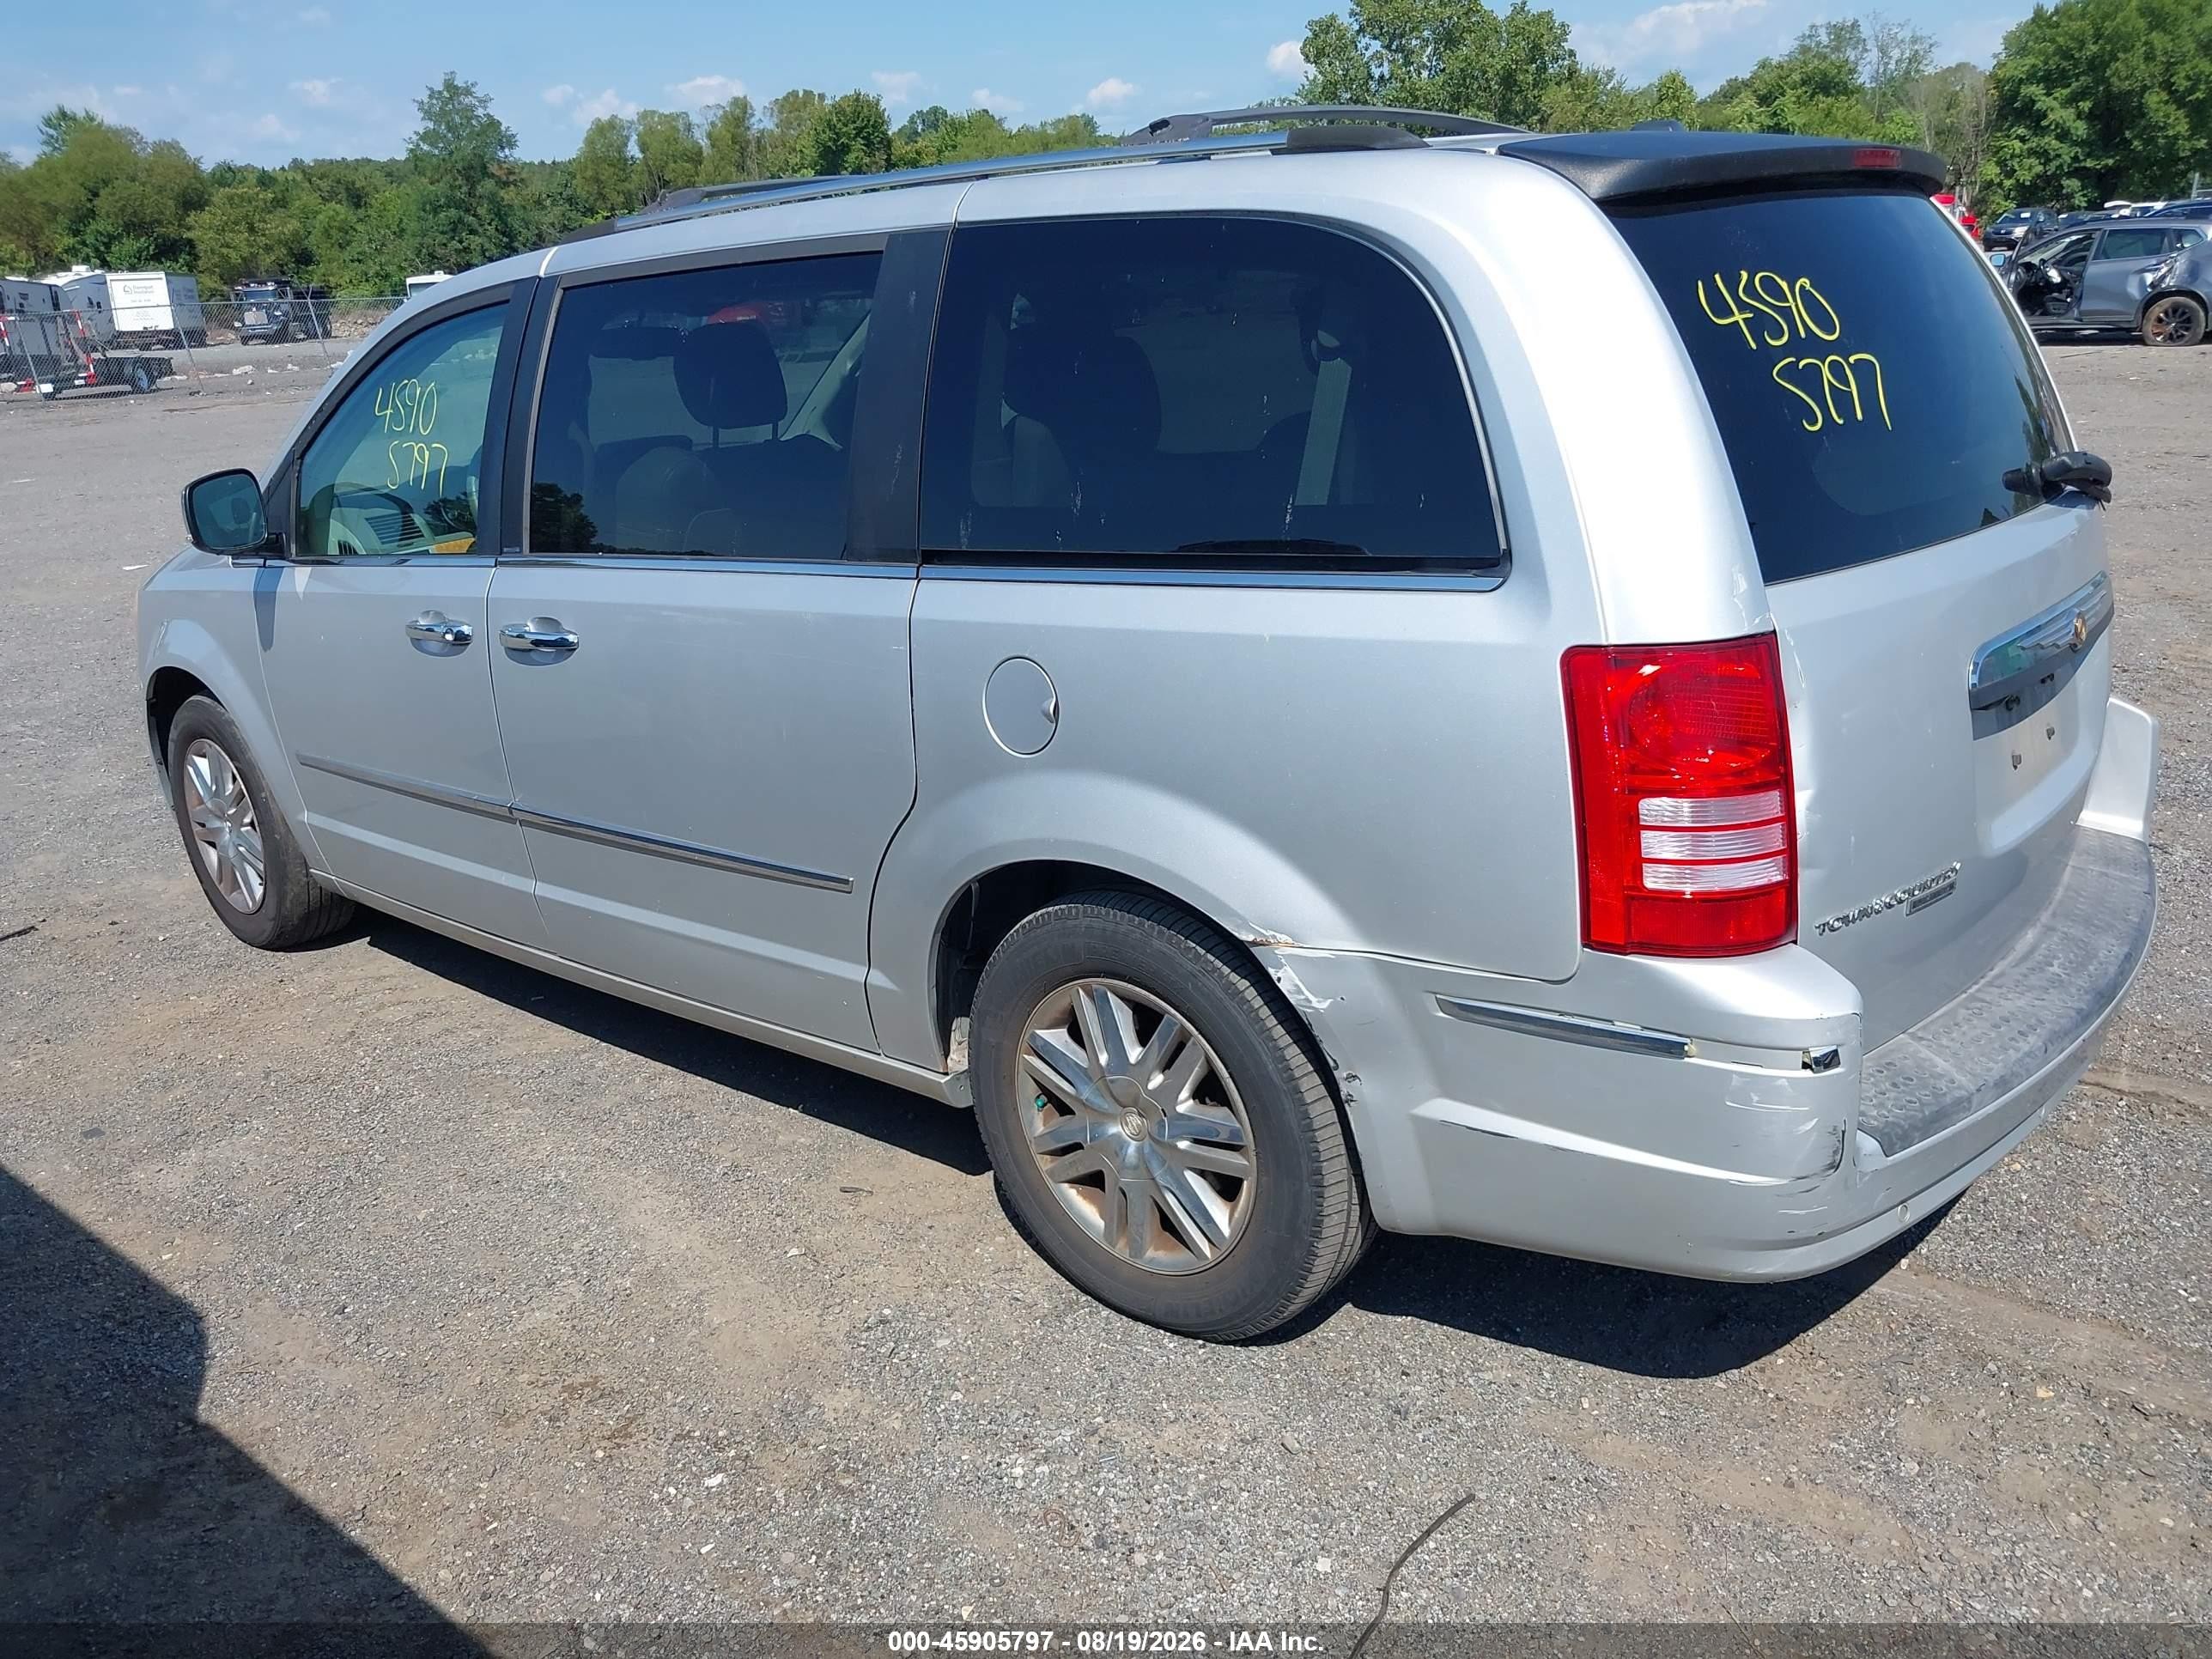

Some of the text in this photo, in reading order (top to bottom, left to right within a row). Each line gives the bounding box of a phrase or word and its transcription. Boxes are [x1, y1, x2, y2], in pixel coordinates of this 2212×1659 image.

[1697, 270, 1840, 349] 4590
[374, 378, 437, 435] 4590
[1772, 353, 1892, 431] 5797
[387, 440, 448, 497] 5797
